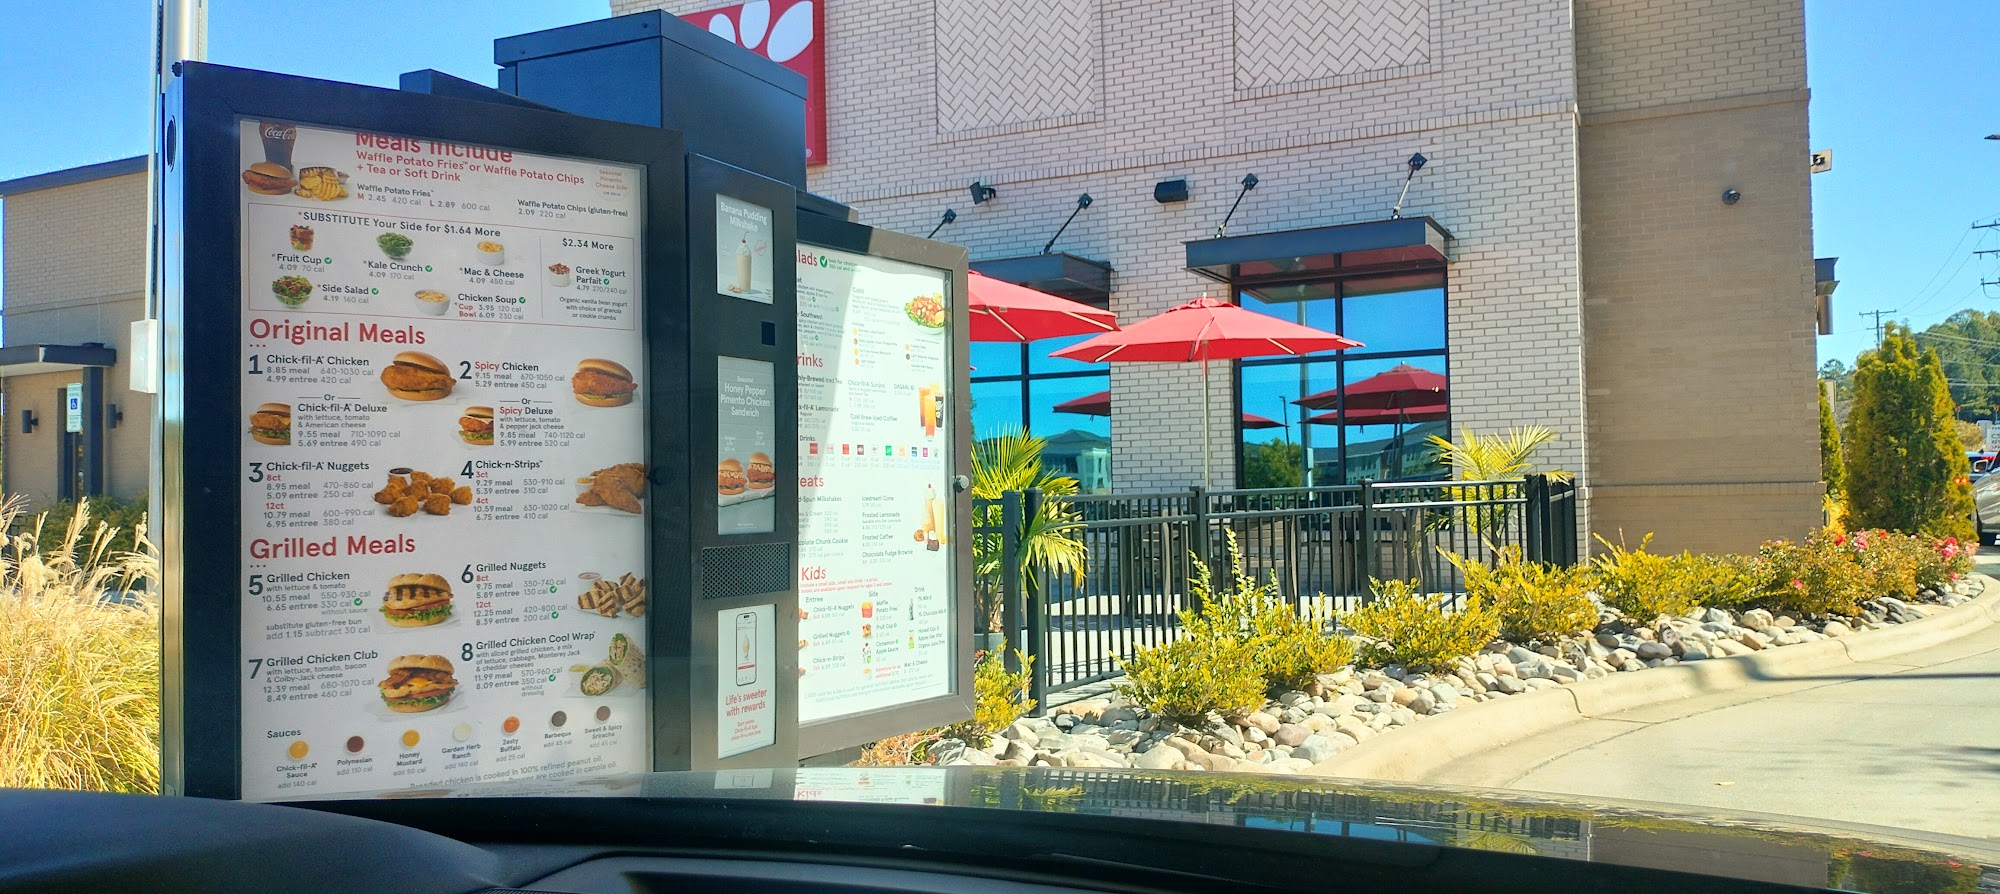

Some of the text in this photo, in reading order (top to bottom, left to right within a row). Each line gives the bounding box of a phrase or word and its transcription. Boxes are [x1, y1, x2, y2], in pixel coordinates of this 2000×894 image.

[356, 132, 421, 153] Meals
[357, 151, 392, 163] Waffle
[397, 155, 434, 168] Potato
[484, 164, 517, 176] Waffle
[521, 169, 553, 180] Potato
[557, 174, 584, 185] Chips
[368, 164, 386, 173] Tea
[405, 166, 427, 178] Soft
[432, 172, 461, 182] Drink
[358, 184, 382, 193] Waffle
[385, 187, 410, 195] Potato
[368, 194, 386, 202] 2.45
[410, 197, 421, 206] cal
[518, 199, 540, 208] Waffle
[567, 205, 586, 213] Chips
[588, 206, 628, 217] (gluten-free)
[721, 202, 767, 225] Banana Pudding
[373, 219, 396, 229] Your
[400, 222, 422, 231] Side
[426, 222, 442, 233] for
[444, 224, 471, 235] $1.64
[475, 228, 500, 236] More
[730, 216, 758, 231] Milkshake
[562, 238, 614, 250] $2.34 More
[277, 254, 321, 265] Fruit Cup
[798, 250, 817, 266] lads
[368, 261, 423, 272] Kale Crunch
[464, 268, 482, 276] Mac
[494, 270, 524, 278] Cheese
[576, 266, 626, 278] Greek Yogurt
[576, 276, 602, 285] Parfait
[322, 284, 368, 295] Side Salad
[458, 294, 516, 304] Chicken Soup
[250, 319, 426, 345] Original Meals
[249, 355, 263, 375] 1
[327, 356, 369, 366] Chicken
[797, 353, 823, 367] rinks
[460, 361, 539, 380] 2 Spicy Chicken
[724, 383, 766, 396] Honey Pepper
[720, 394, 770, 407] Pimento Chicken
[355, 404, 387, 412] Deluxe
[500, 407, 522, 416] Spicy
[731, 407, 759, 417] Sandwich
[249, 463, 263, 482] 3
[328, 462, 369, 472] Nuggets
[461, 461, 474, 478] 4
[800, 475, 824, 487] eats
[250, 534, 416, 559] Grilled Meals
[461, 561, 546, 583] 6 Grilled Nuggets
[801, 567, 826, 581] Kids
[249, 572, 350, 595] 5 Grilled Chicken
[461, 643, 473, 661] 8
[476, 641, 507, 650] Grilled
[510, 637, 546, 647] Chicken
[549, 633, 570, 643] Cool
[249, 650, 378, 679] 7 Grilled Chicken Club
[726, 689, 767, 705] Life's sweeter
[726, 700, 765, 717] with rewards
[267, 729, 301, 739] Sauces
[400, 752, 420, 760] Honey
[442, 746, 464, 754] Garden
[337, 757, 373, 766] Polynesian
[397, 758, 422, 767] Mustard
[484, 770, 510, 780] cooked
[541, 761, 565, 771] refined
[567, 758, 591, 768] peanut
